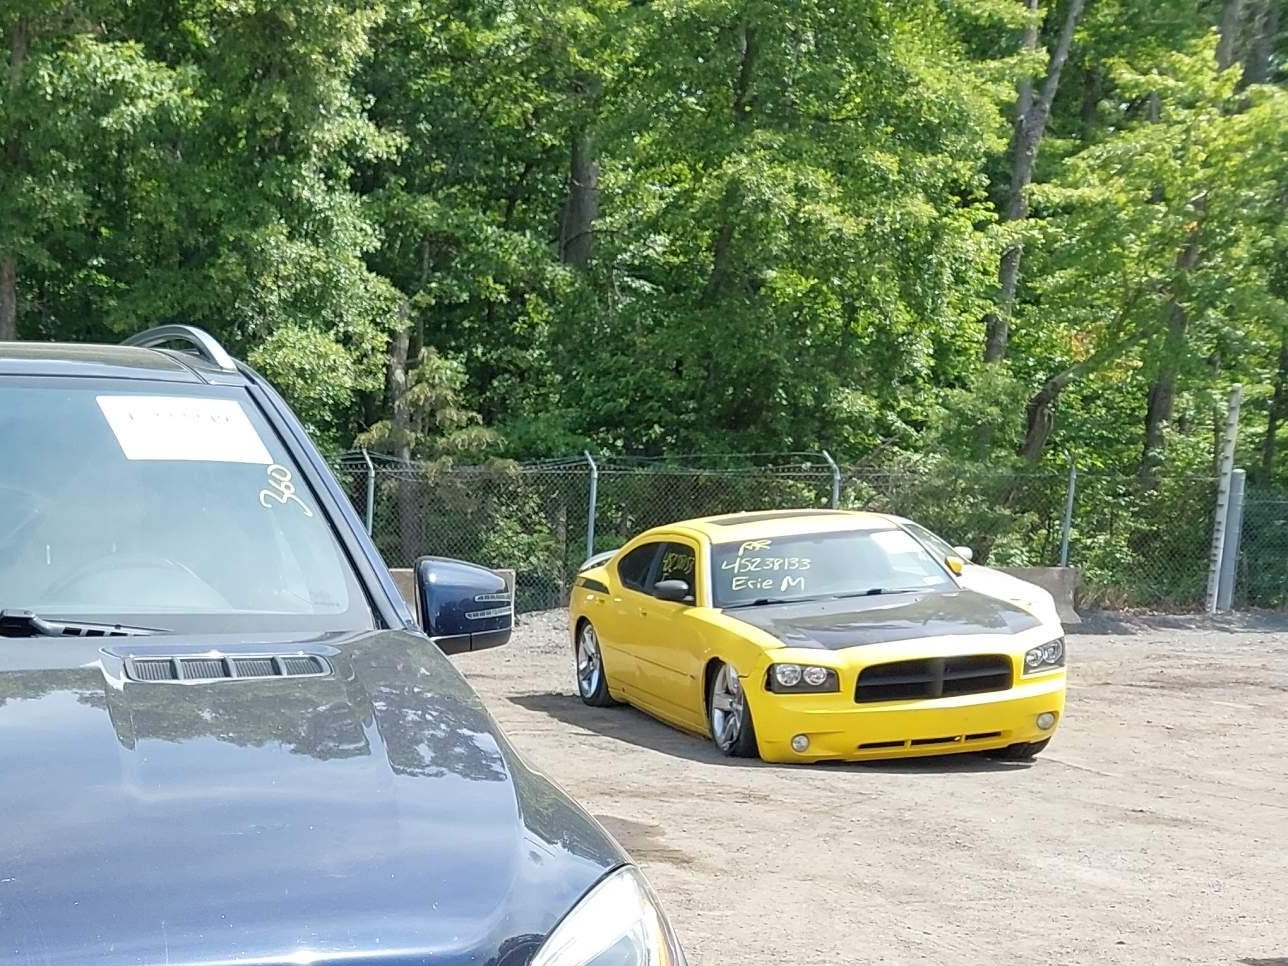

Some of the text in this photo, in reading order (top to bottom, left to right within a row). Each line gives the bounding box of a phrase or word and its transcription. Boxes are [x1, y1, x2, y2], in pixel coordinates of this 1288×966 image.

[259, 463, 314, 517] 360
[721, 557, 812, 574] 45238133
[731, 575, 805, 592] Erie M
